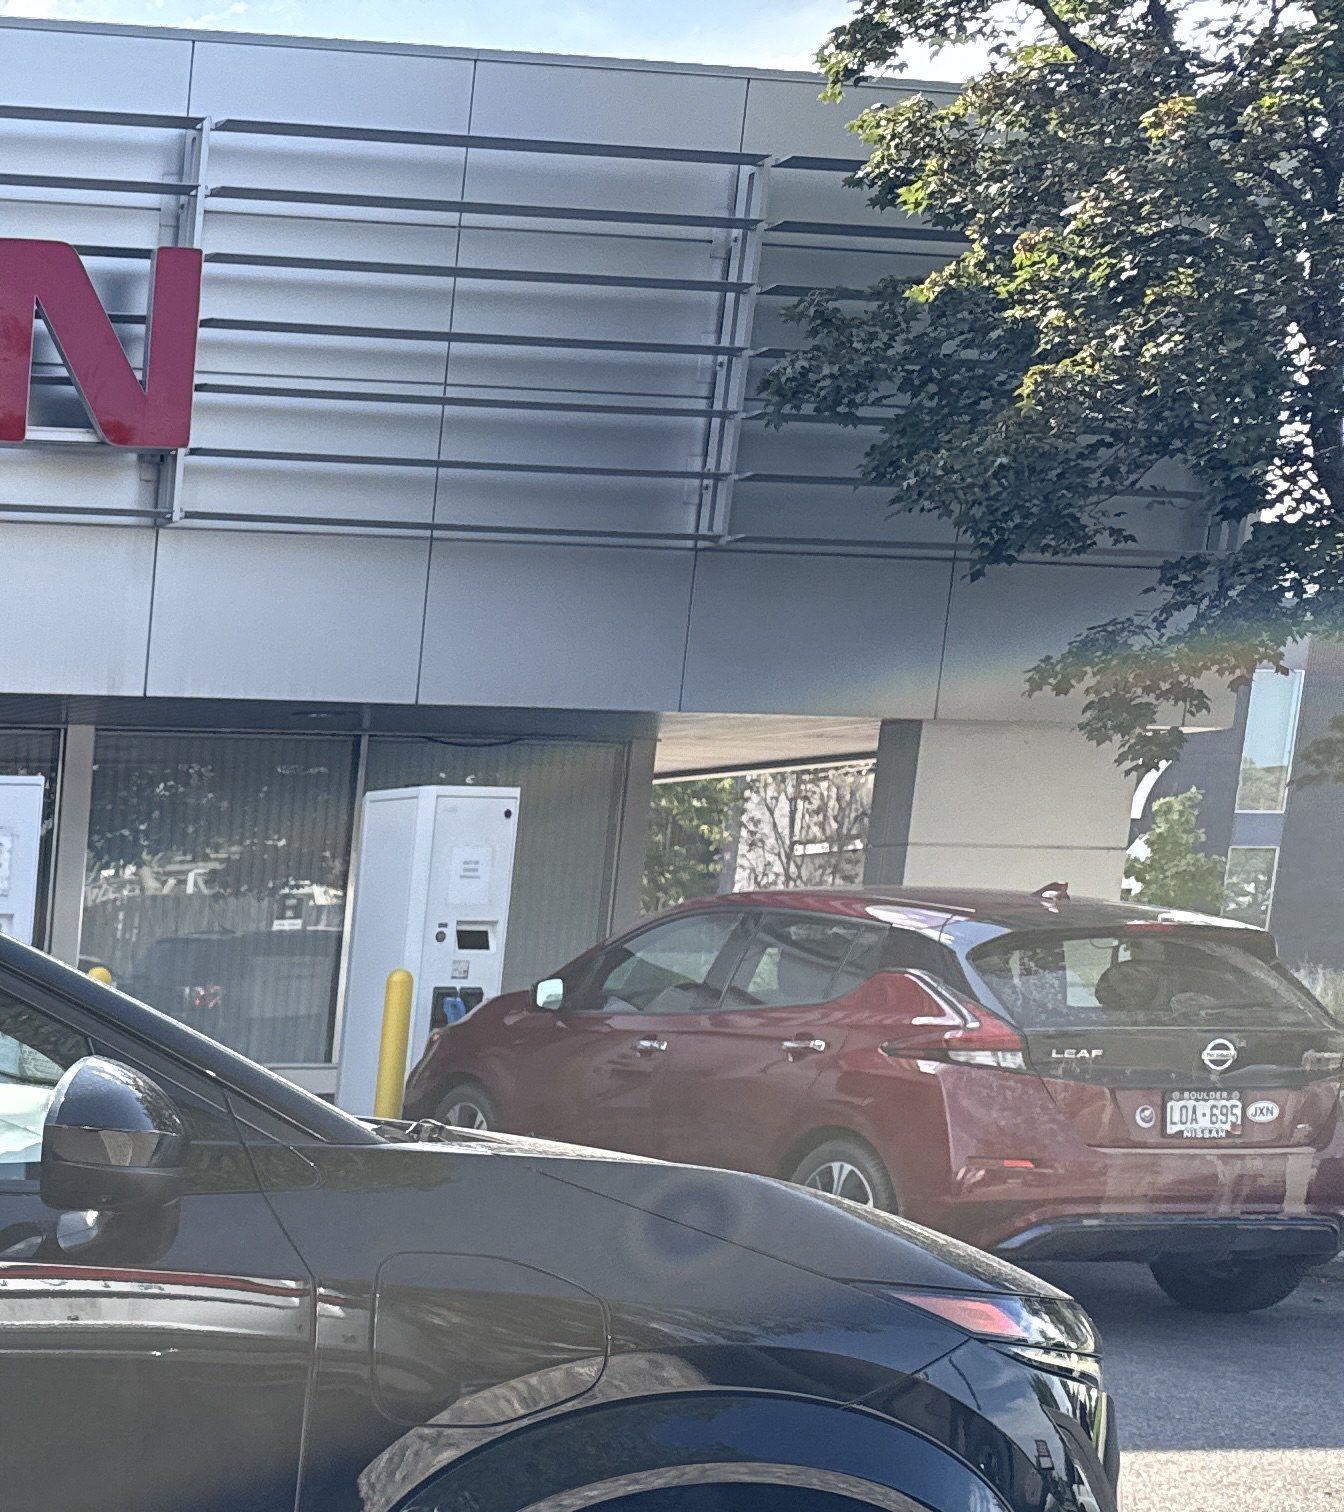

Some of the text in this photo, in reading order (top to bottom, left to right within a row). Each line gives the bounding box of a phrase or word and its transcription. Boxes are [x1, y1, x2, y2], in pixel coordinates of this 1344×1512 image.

[1051, 1049, 1104, 1058] LEAF
[1183, 1091, 1228, 1099] BOULDER
[1250, 1106, 1275, 1118] JXN
[1182, 1127, 1227, 1139] NISSAN
